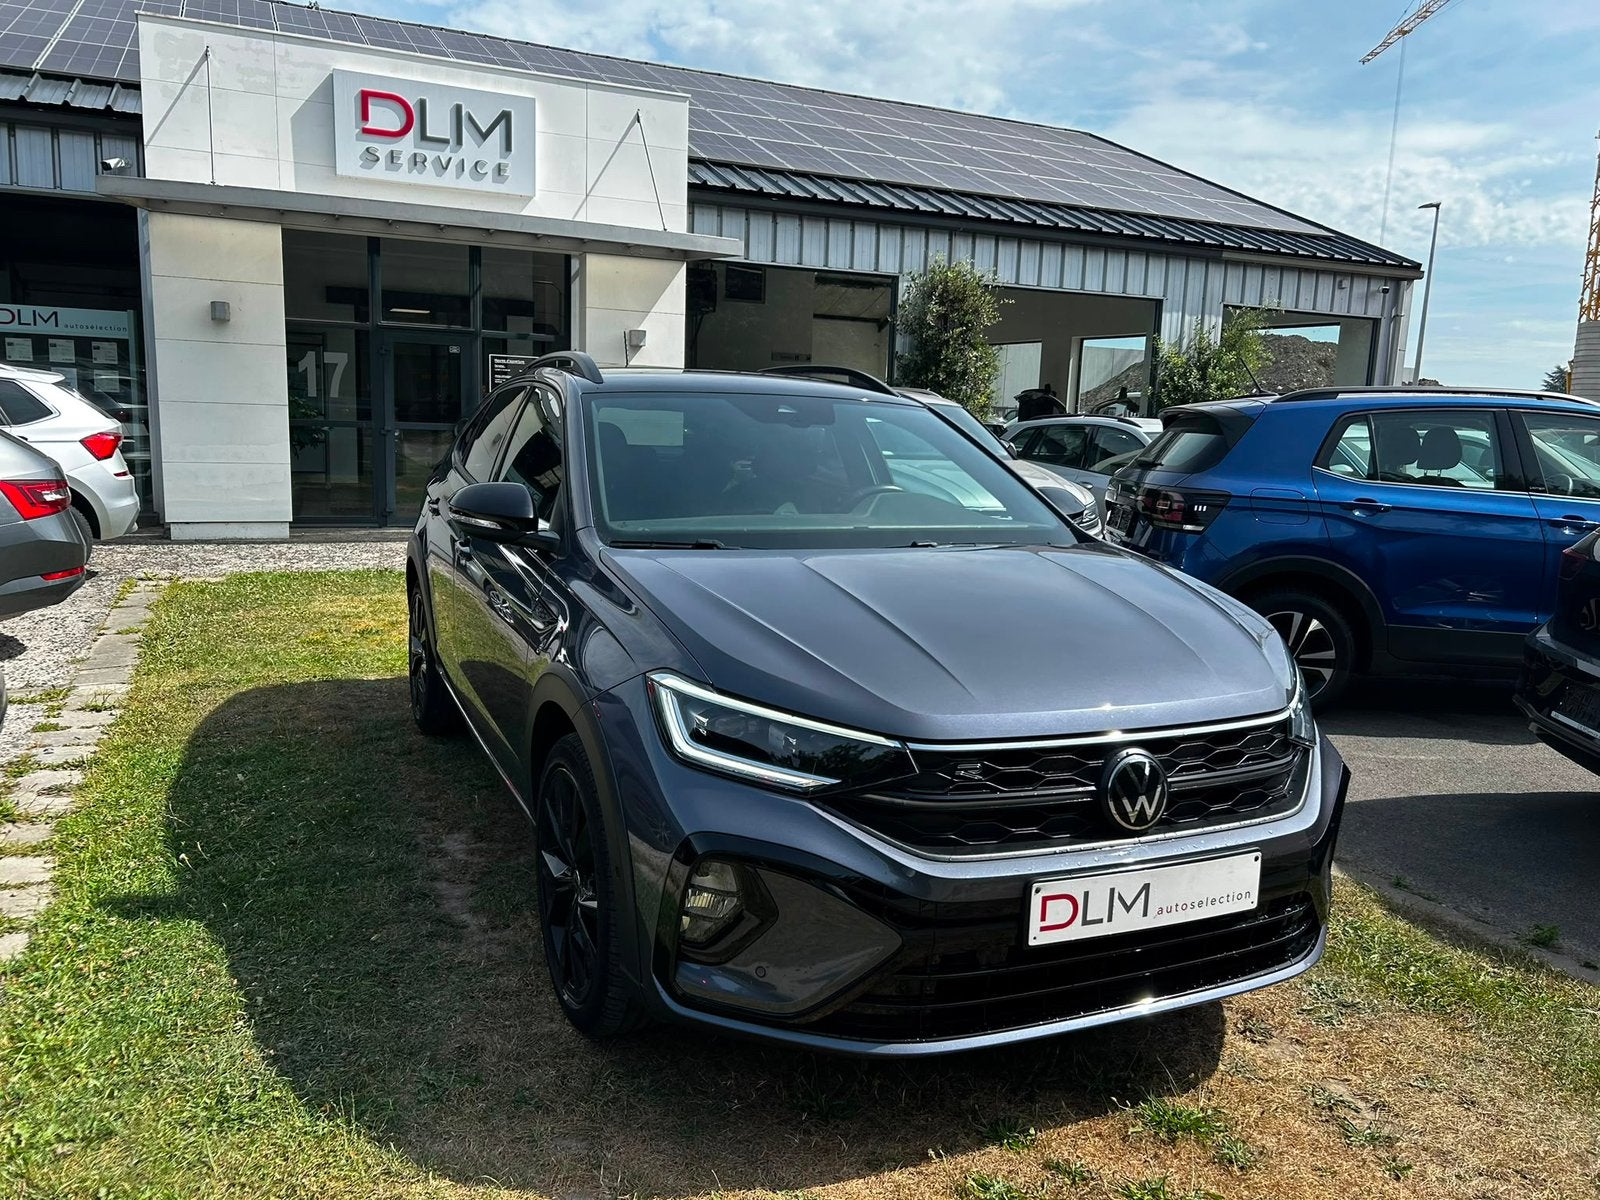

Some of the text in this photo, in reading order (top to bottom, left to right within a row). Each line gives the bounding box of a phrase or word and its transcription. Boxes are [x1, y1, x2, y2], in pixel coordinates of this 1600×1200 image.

[360, 89, 512, 152] DLM
[364, 146, 513, 177] SERVICE
[298, 351, 348, 398] 17
[1039, 882, 1151, 932] DLM
